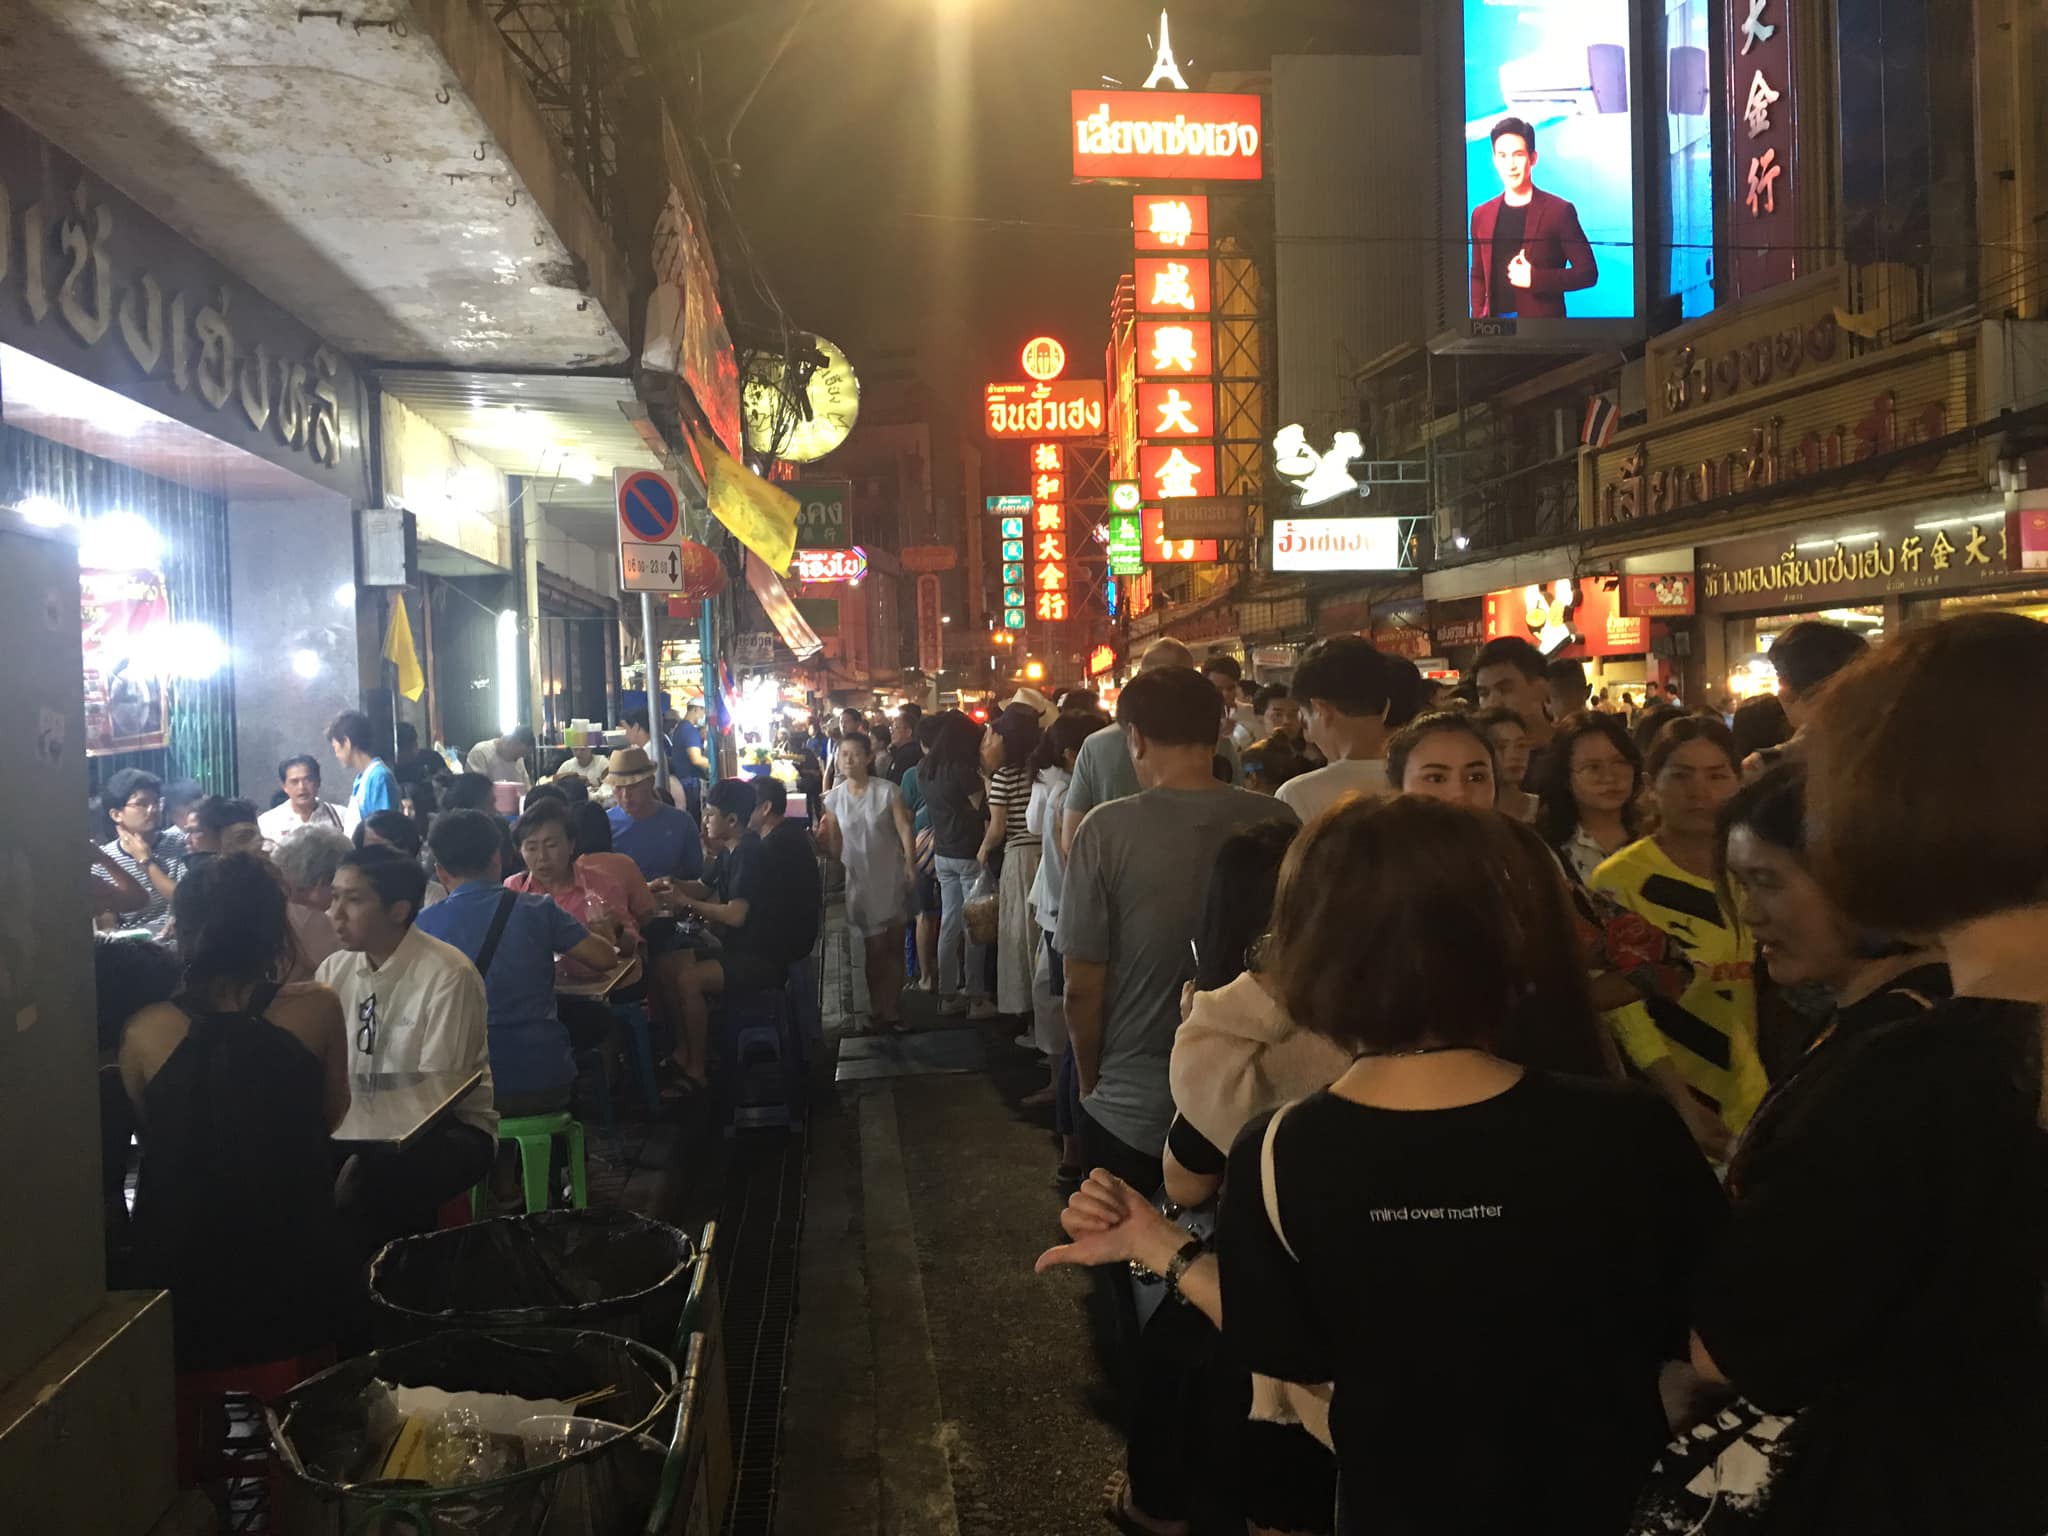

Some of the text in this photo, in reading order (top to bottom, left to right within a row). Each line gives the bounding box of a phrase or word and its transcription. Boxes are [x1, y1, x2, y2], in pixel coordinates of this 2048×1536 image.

[1369, 1204, 1503, 1222] mind over matter
